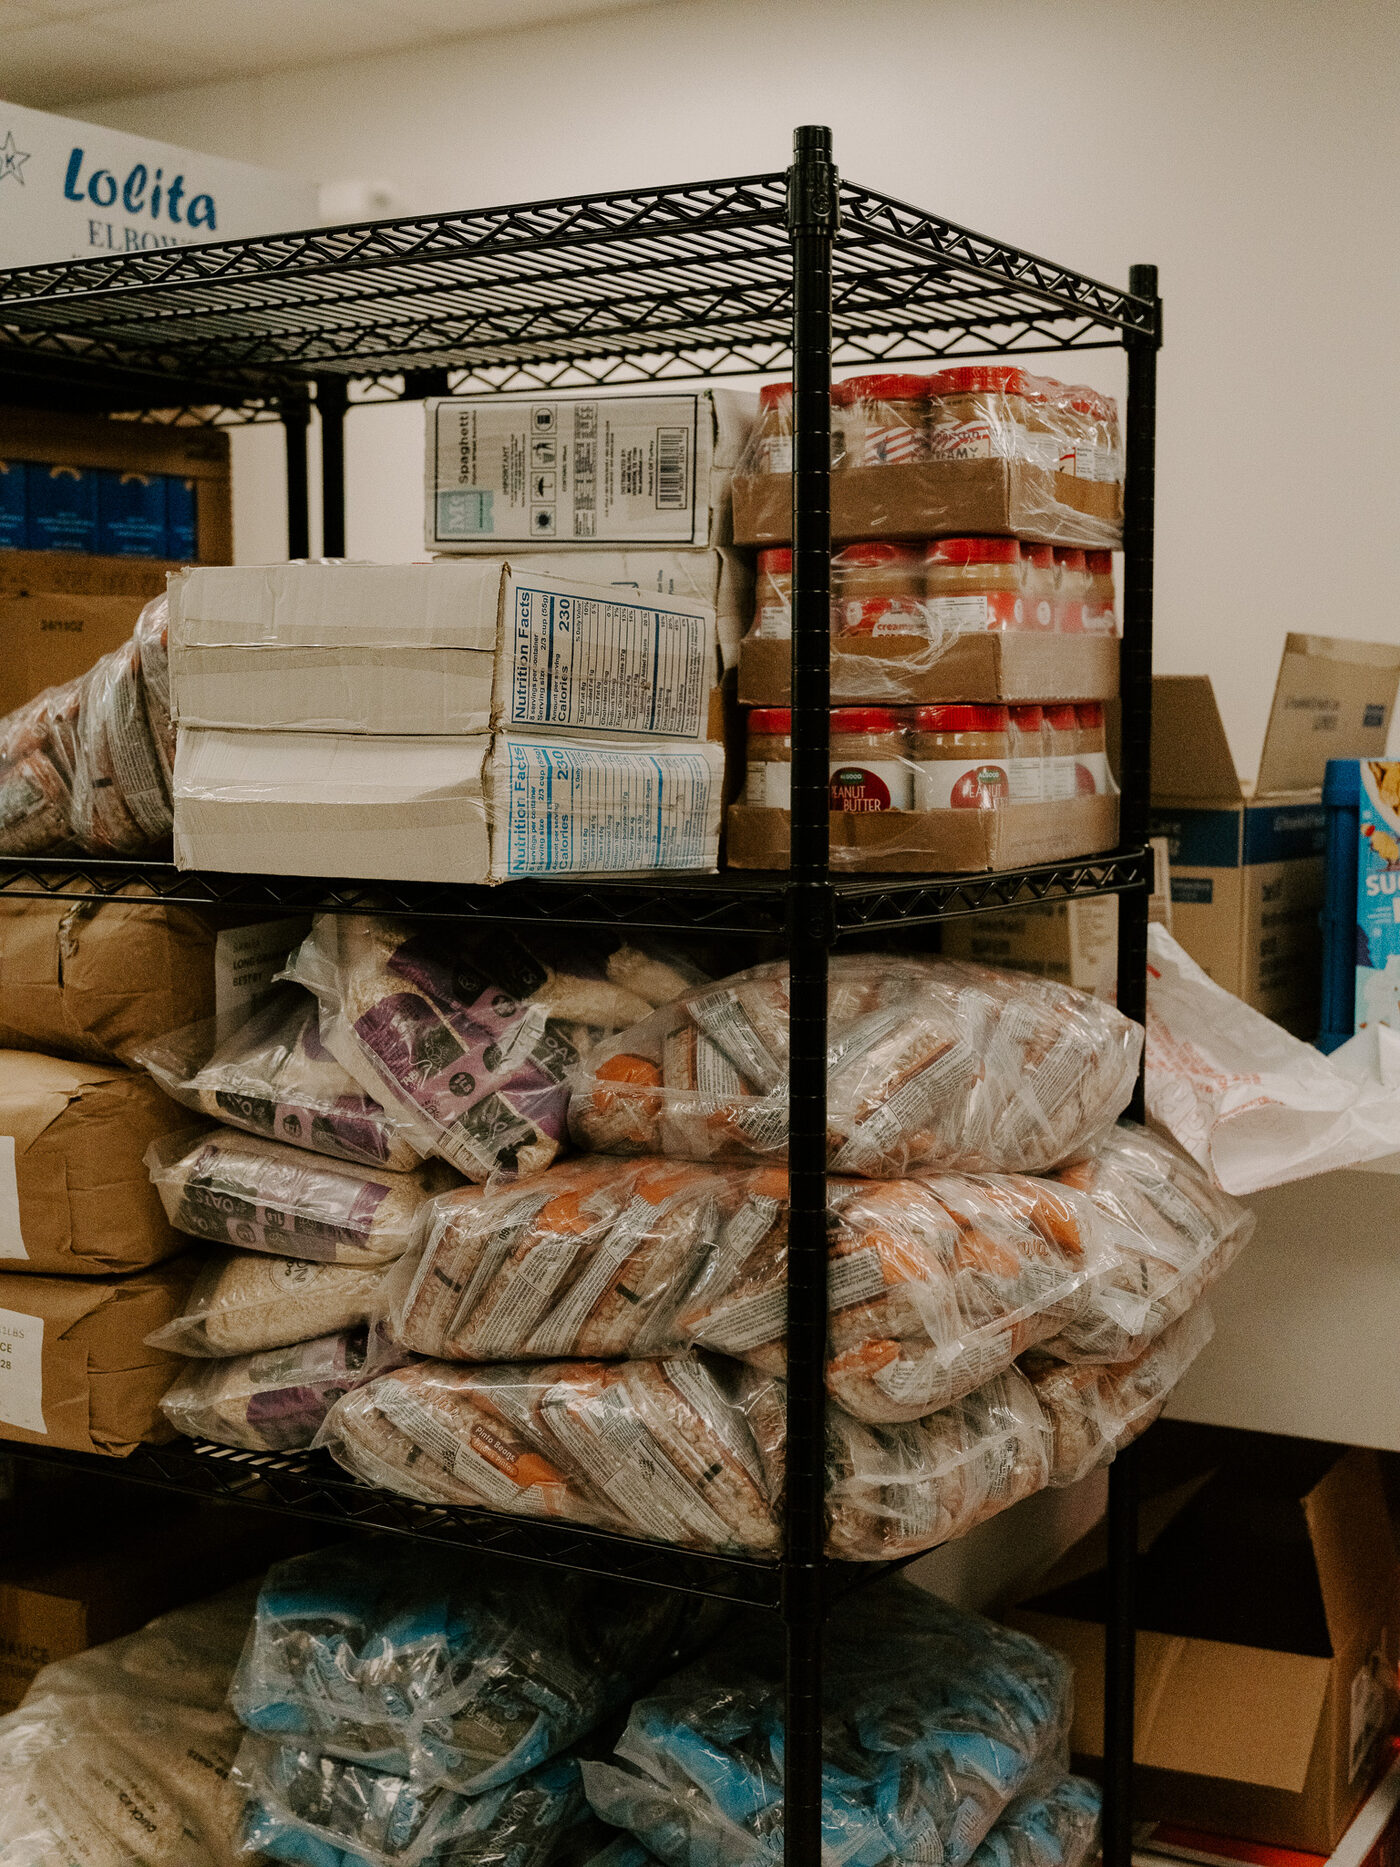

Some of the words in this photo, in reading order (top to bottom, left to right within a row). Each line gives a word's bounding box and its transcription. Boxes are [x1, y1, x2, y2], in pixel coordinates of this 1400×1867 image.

[63, 147, 217, 231] Lolita
[458, 411, 470, 485] Spaghetti
[518, 592, 530, 639] Facts
[558, 599, 570, 632] 230
[537, 688, 545, 721] Serving
[541, 595, 549, 617] (55g)
[515, 645, 528, 719] Nutrition
[530, 683, 538, 715] servings
[558, 665, 569, 722] Calories
[513, 747, 526, 791] Facts
[551, 750, 569, 780] 230
[843, 798, 881, 812] BUTTER
[512, 796, 526, 871] Nutrition
[559, 814, 569, 870] Calories
[1365, 872, 1400, 897] SU
[475, 1426, 494, 1444] Pinto
[493, 1441, 517, 1463] Beans
